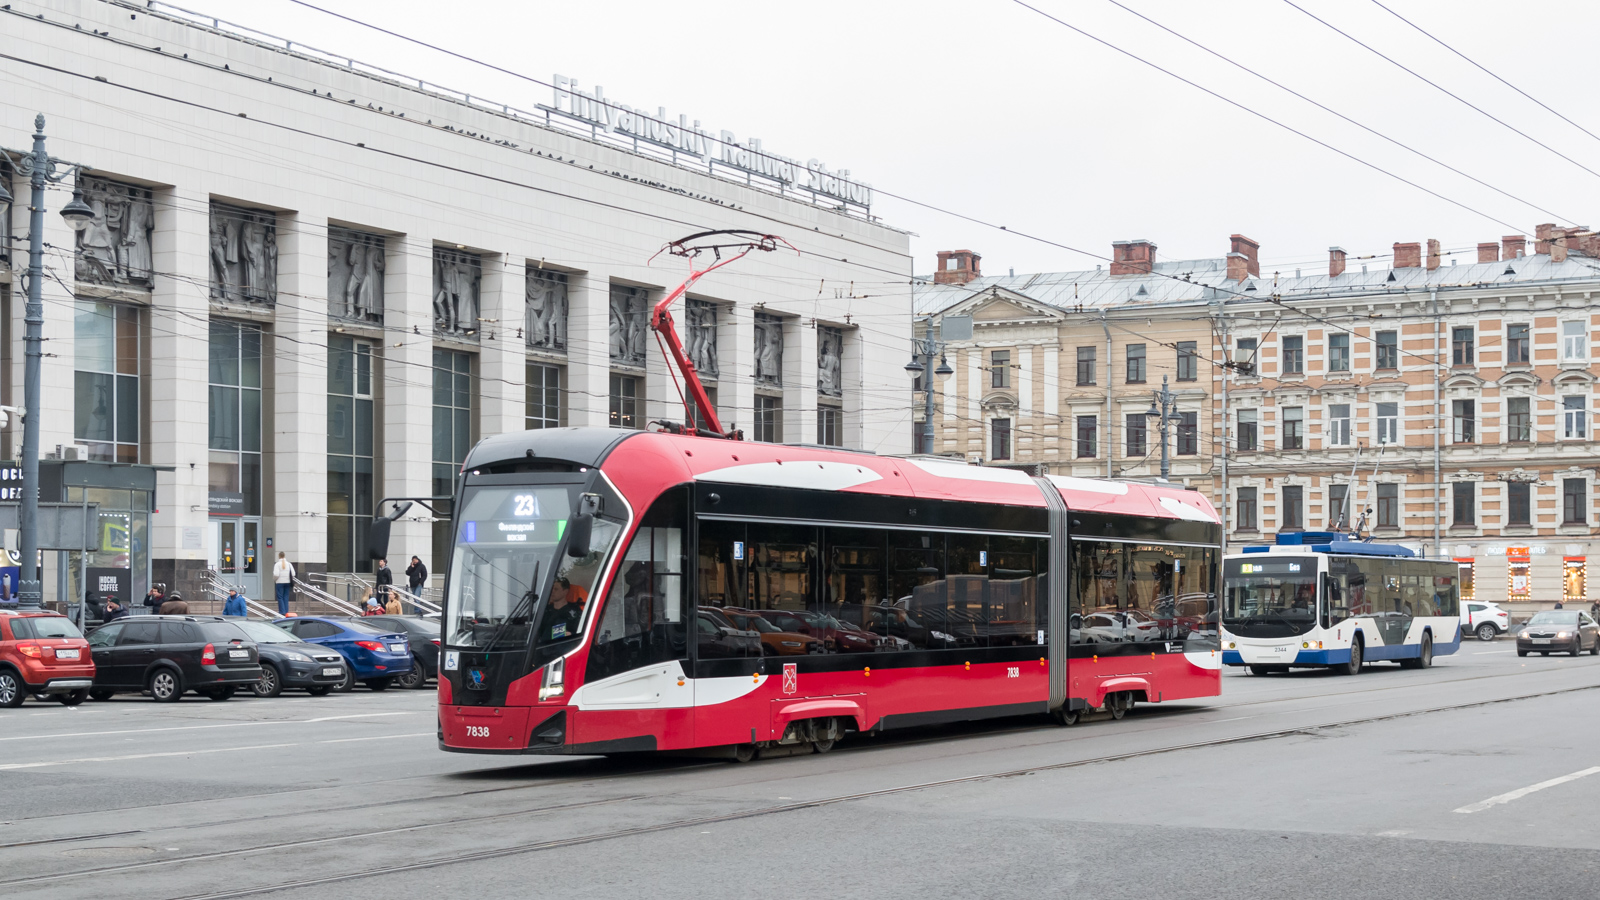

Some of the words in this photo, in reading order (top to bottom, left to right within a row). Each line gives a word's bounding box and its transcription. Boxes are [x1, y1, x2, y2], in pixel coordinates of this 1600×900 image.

[553, 73, 715, 163] Finlyandskiy
[720, 129, 801, 190] Railway
[807, 158, 874, 205] Station
[514, 494, 535, 516] 23
[100, 584, 119, 592] COFFEE
[1007, 667, 1020, 678] 7838
[466, 725, 490, 737] 7838
